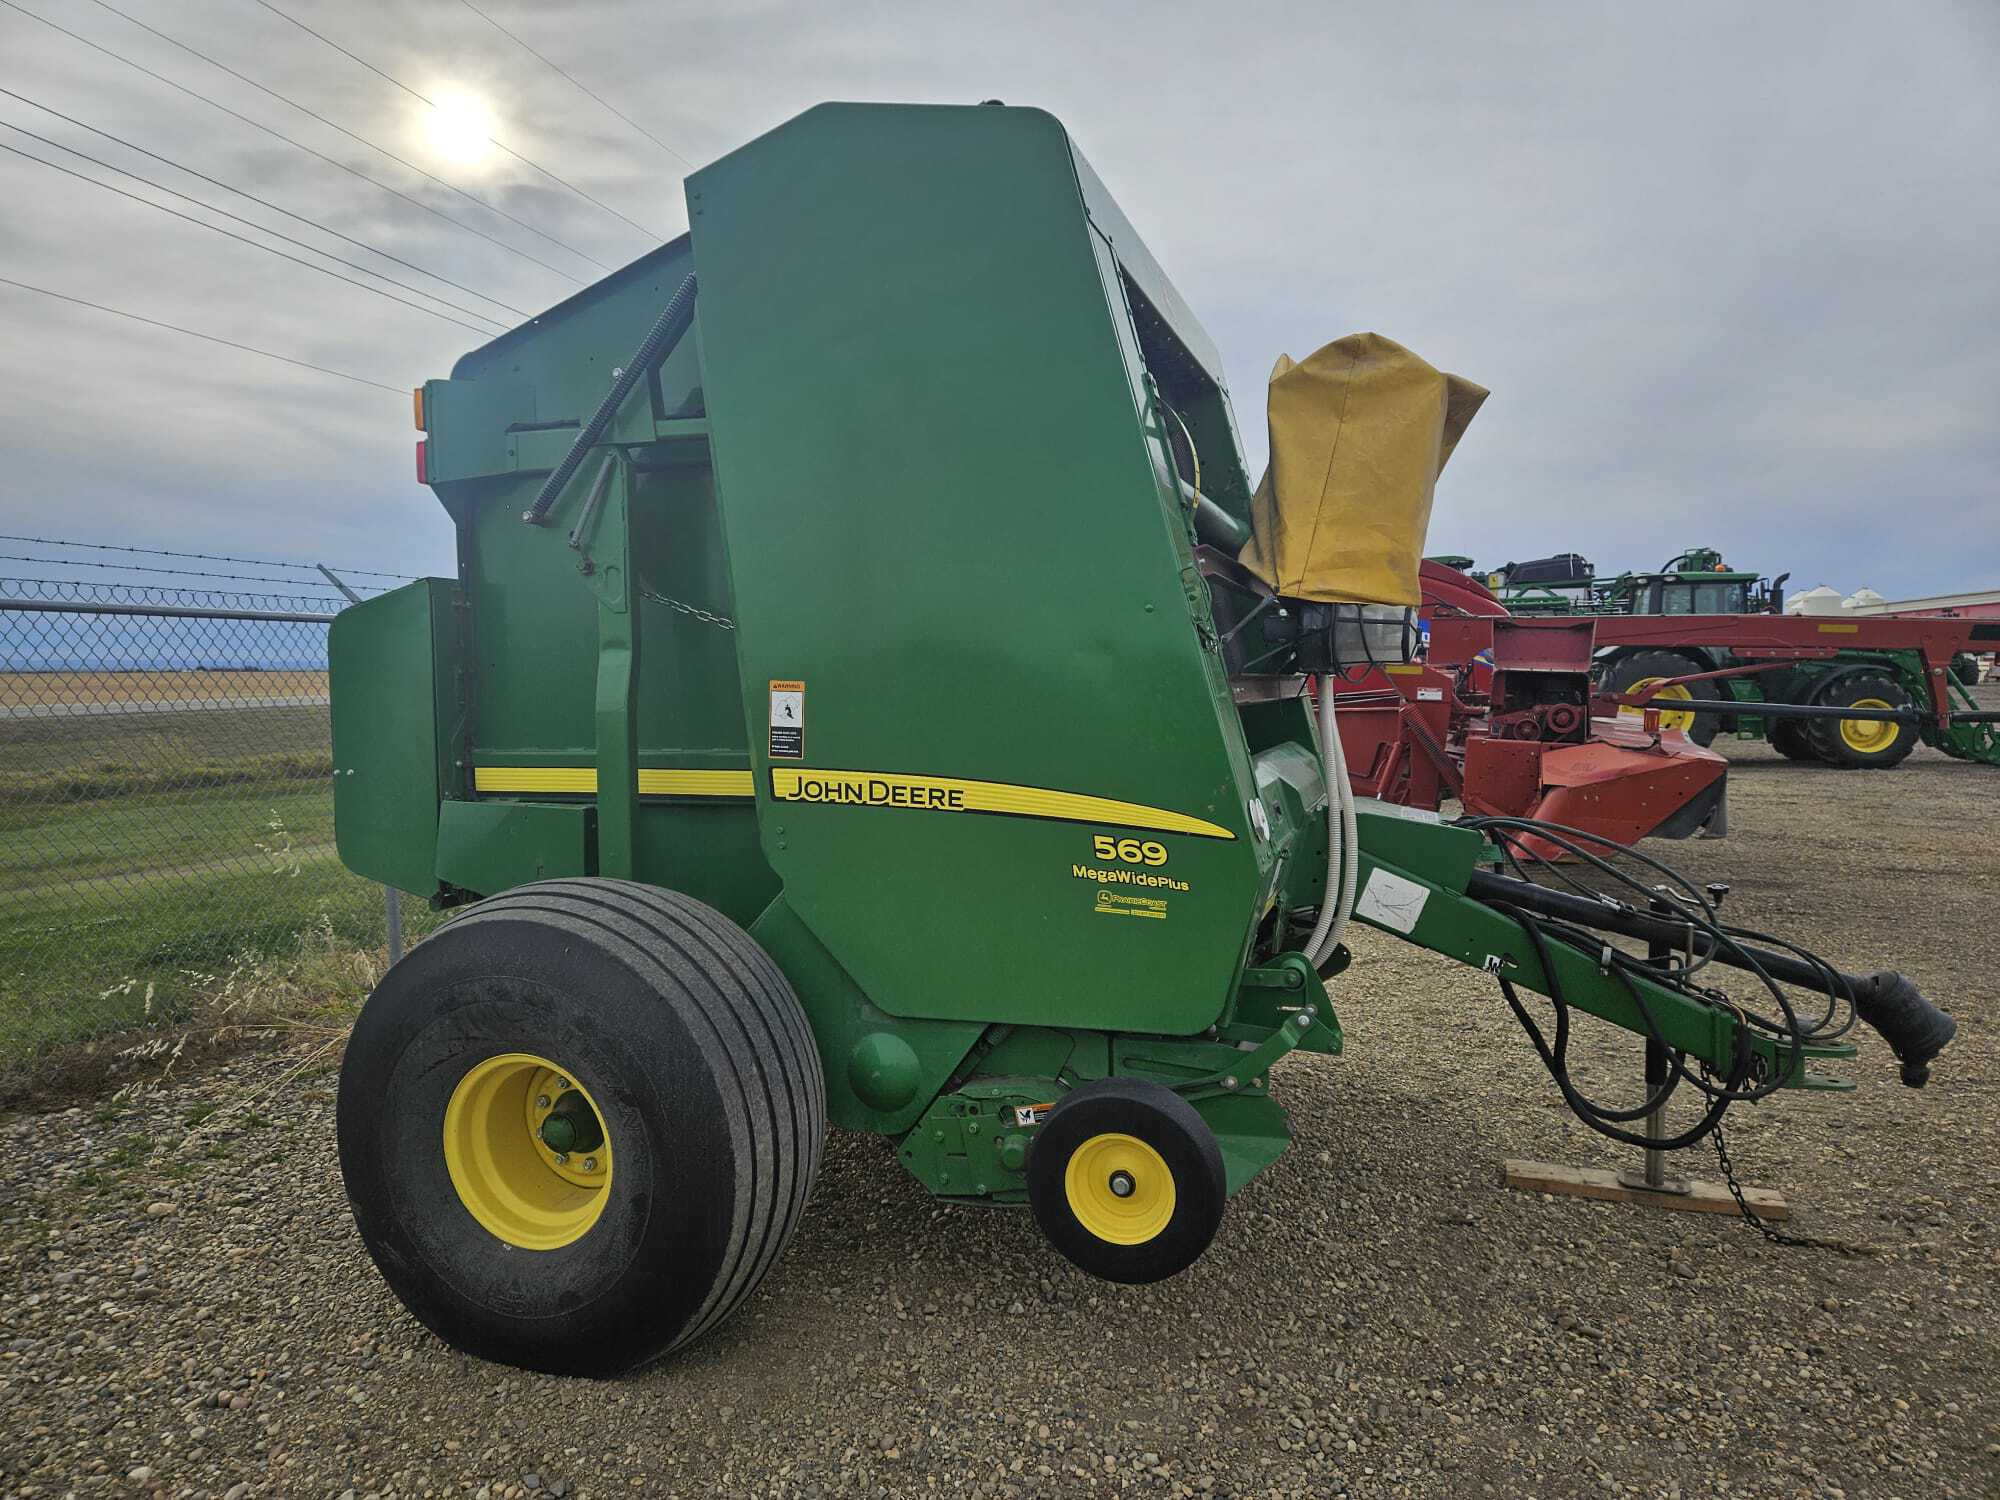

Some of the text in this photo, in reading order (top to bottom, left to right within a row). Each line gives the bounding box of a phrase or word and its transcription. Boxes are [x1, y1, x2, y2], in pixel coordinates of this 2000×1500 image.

[789, 776, 965, 808] JOHN DEERE
[1093, 834, 1168, 867] 569
[1072, 864, 1190, 891] MegaWidePlus
